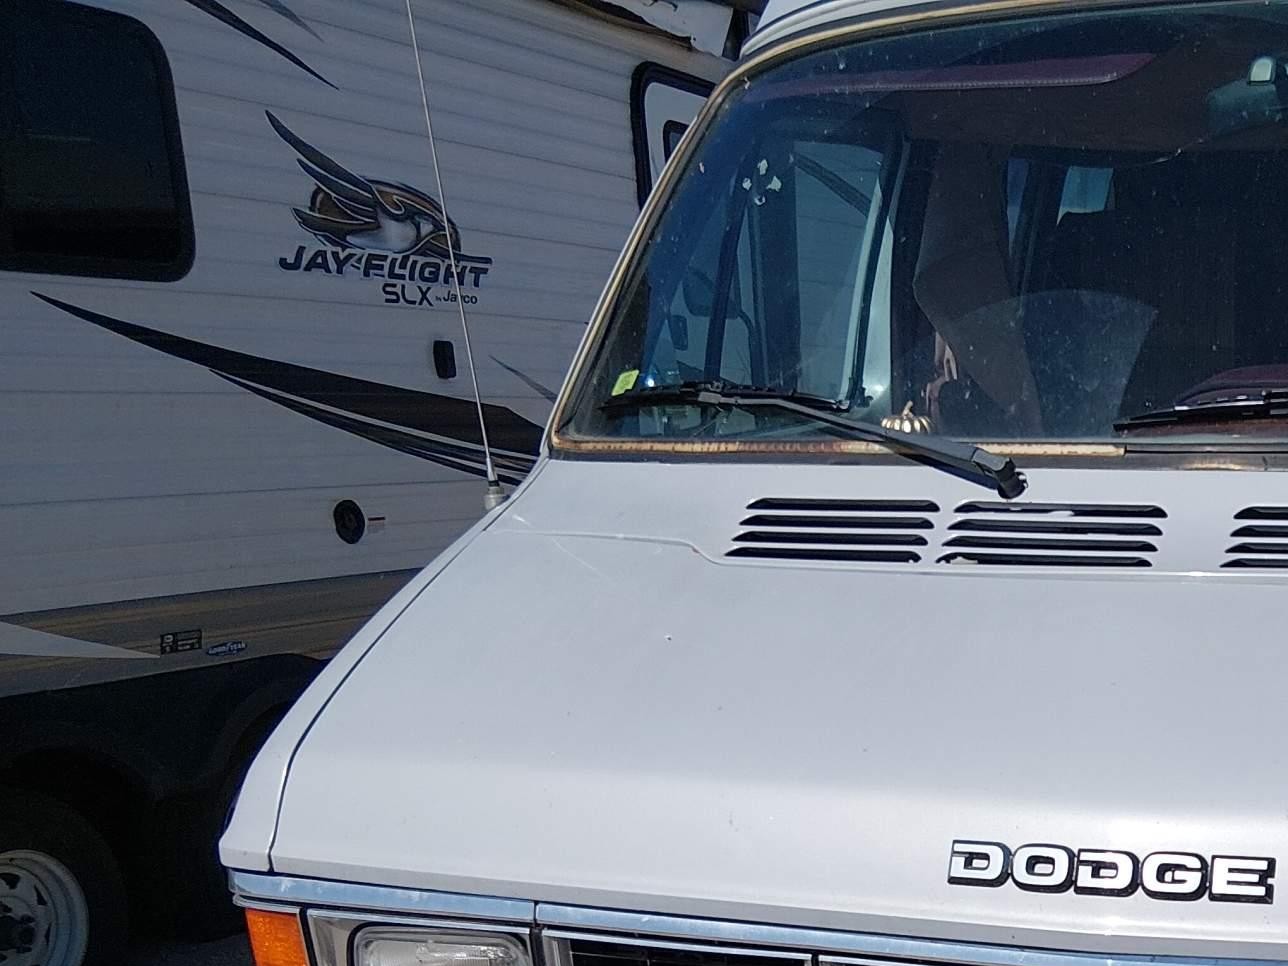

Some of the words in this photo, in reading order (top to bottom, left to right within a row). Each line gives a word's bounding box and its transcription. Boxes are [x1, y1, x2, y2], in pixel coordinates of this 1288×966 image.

[279, 246, 350, 275] JAY
[363, 252, 489, 288] FLIGHT
[382, 283, 434, 307] SLX
[947, 839, 1276, 905] DODGE
